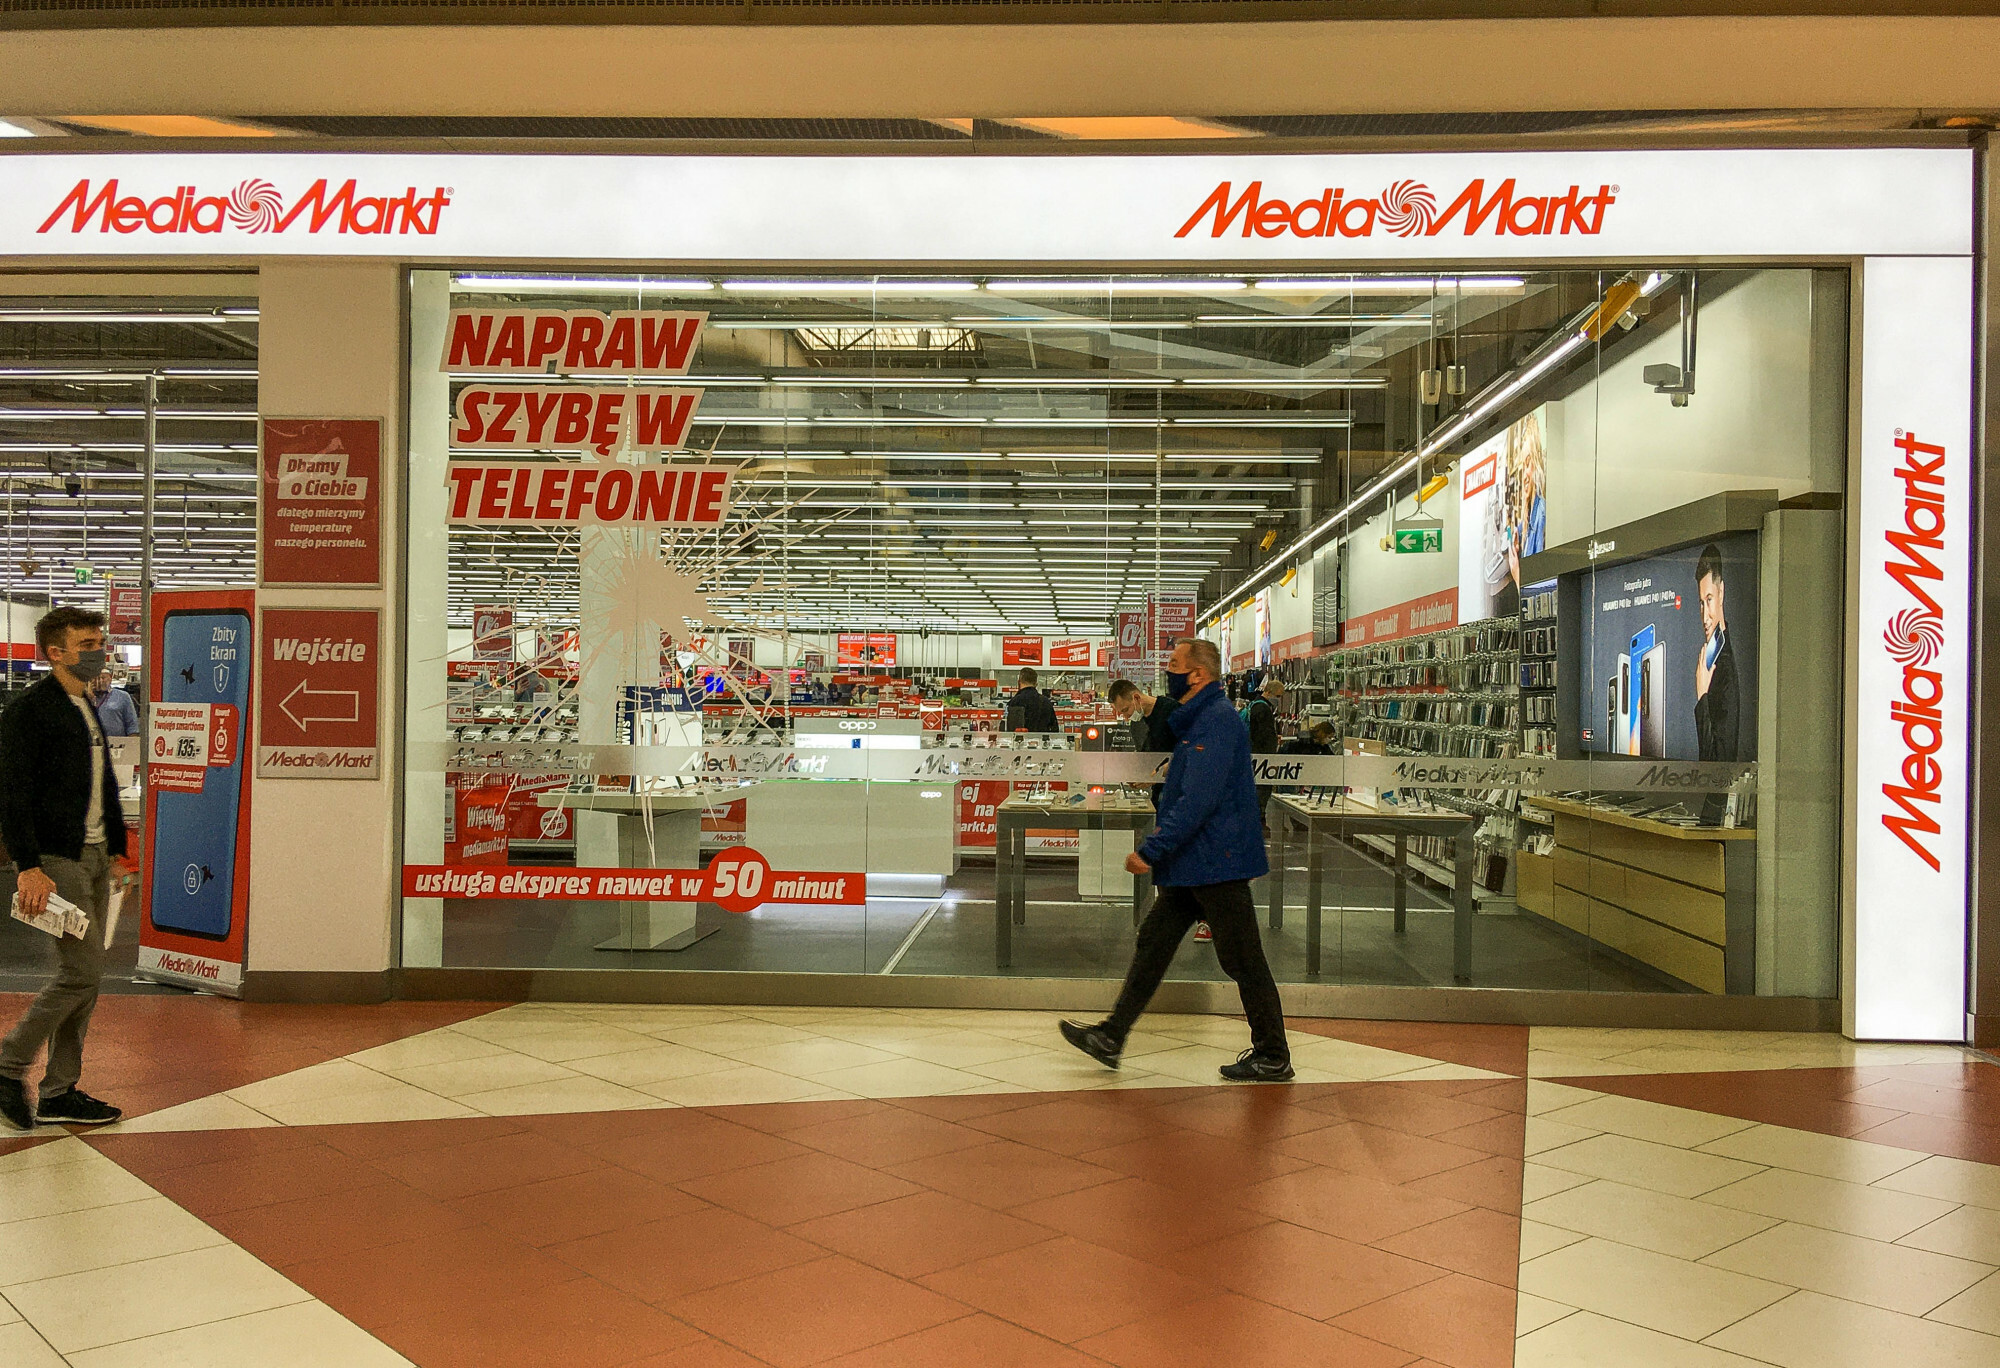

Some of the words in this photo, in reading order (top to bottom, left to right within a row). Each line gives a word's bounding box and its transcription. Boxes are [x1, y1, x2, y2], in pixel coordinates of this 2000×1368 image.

[36, 178, 228, 234] Media
[273, 178, 451, 235] Markt
[1173, 180, 1378, 238] Media
[1425, 178, 1615, 236] Markt
[447, 314, 700, 369] NAPRAW
[457, 390, 626, 457] SZYBĘ
[636, 394, 696, 446] W
[286, 458, 341, 476] Dbamy
[290, 482, 303, 496] o
[305, 479, 358, 497] Ciebie
[450, 467, 728, 522] TELEFONIE
[277, 507, 314, 519] dlatego
[315, 507, 366, 520] mierzymy
[289, 522, 353, 535] temperaturę
[1884, 432, 1946, 621] Markt
[274, 538, 315, 549] naszego
[315, 537, 367, 549] personelu.
[212, 626, 237, 644] Zbity
[1022, 637, 1041, 645] super!
[210, 646, 236, 661] Ekran
[273, 637, 366, 665] Wejście
[838, 721, 877, 731] oppo
[264, 751, 315, 767] Media
[325, 752, 371, 768] Markt
[1881, 664, 1943, 873] Media
[1636, 765, 1713, 787] Media
[920, 791, 942, 799] oppo
[467, 803, 496, 829] Więcej
[494, 813, 506, 831] na
[974, 803, 996, 817] na
[463, 834, 508, 858] mediamarkt.pl
[713, 834, 737, 842] Media
[1040, 839, 1066, 848] Media
[415, 869, 495, 898] usługa
[499, 872, 590, 899] ekspres
[597, 876, 672, 897] nawet
[680, 878, 703, 895] w
[712, 861, 764, 898] 50
[772, 877, 846, 900] minut
[157, 953, 184, 973] Media
[192, 959, 219, 979] Markt
